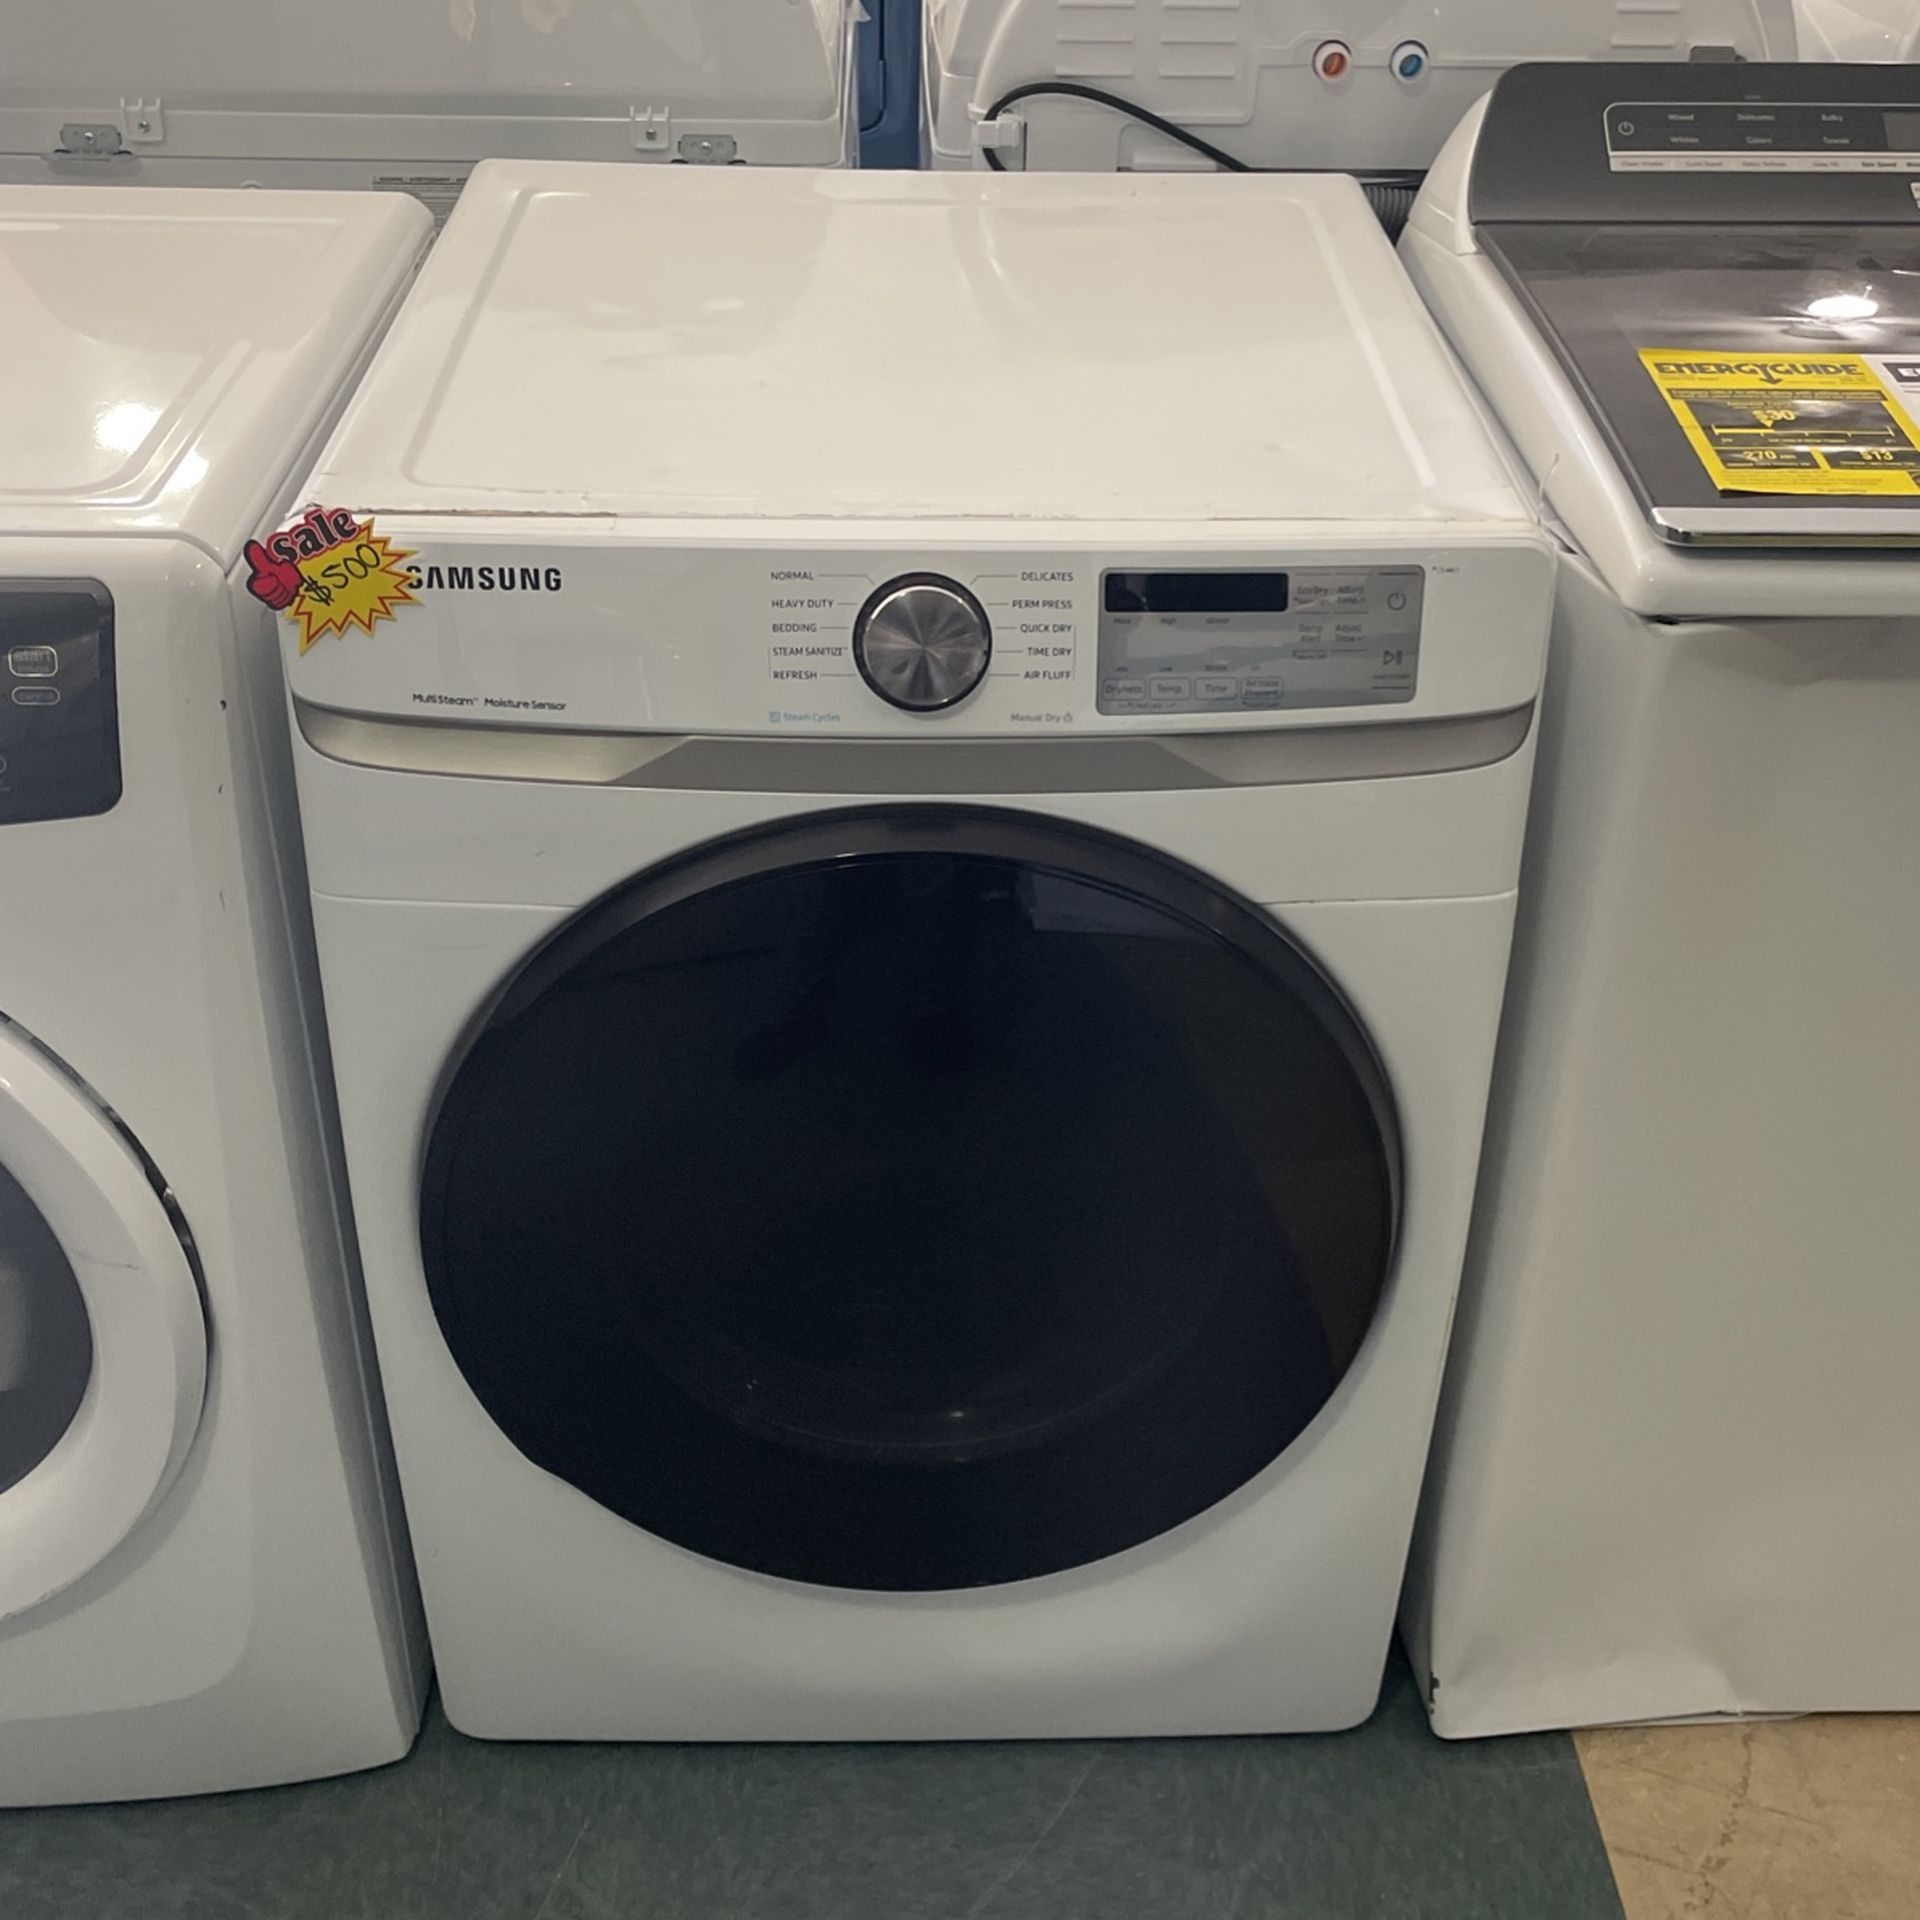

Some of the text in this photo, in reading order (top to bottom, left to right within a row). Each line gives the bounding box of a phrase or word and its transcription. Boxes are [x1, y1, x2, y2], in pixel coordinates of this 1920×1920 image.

[301, 543, 381, 606] $500
[406, 565, 563, 592] SAMSUNG
[771, 571, 814, 580] NORMAL
[1021, 571, 1074, 582] DELICATES
[771, 599, 834, 608] HEAVY DUTY
[1012, 600, 1073, 609] PERM PRESS
[772, 623, 817, 632] BEDDING
[1020, 623, 1072, 633] QUICK DRY
[773, 647, 804, 656] STEAM
[1027, 647, 1072, 656] TIME DRY
[773, 670, 817, 680] REFRESH
[1024, 670, 1072, 680] AIR FLUFF
[1105, 684, 1143, 696] Dryness
[1157, 684, 1182, 696] Temp
[1206, 683, 1228, 692] Time
[484, 697, 530, 710] Moisture
[531, 700, 567, 711] Sensor
[783, 712, 841, 723] Steam Cycles
[1010, 713, 1060, 723] Manual Dry
